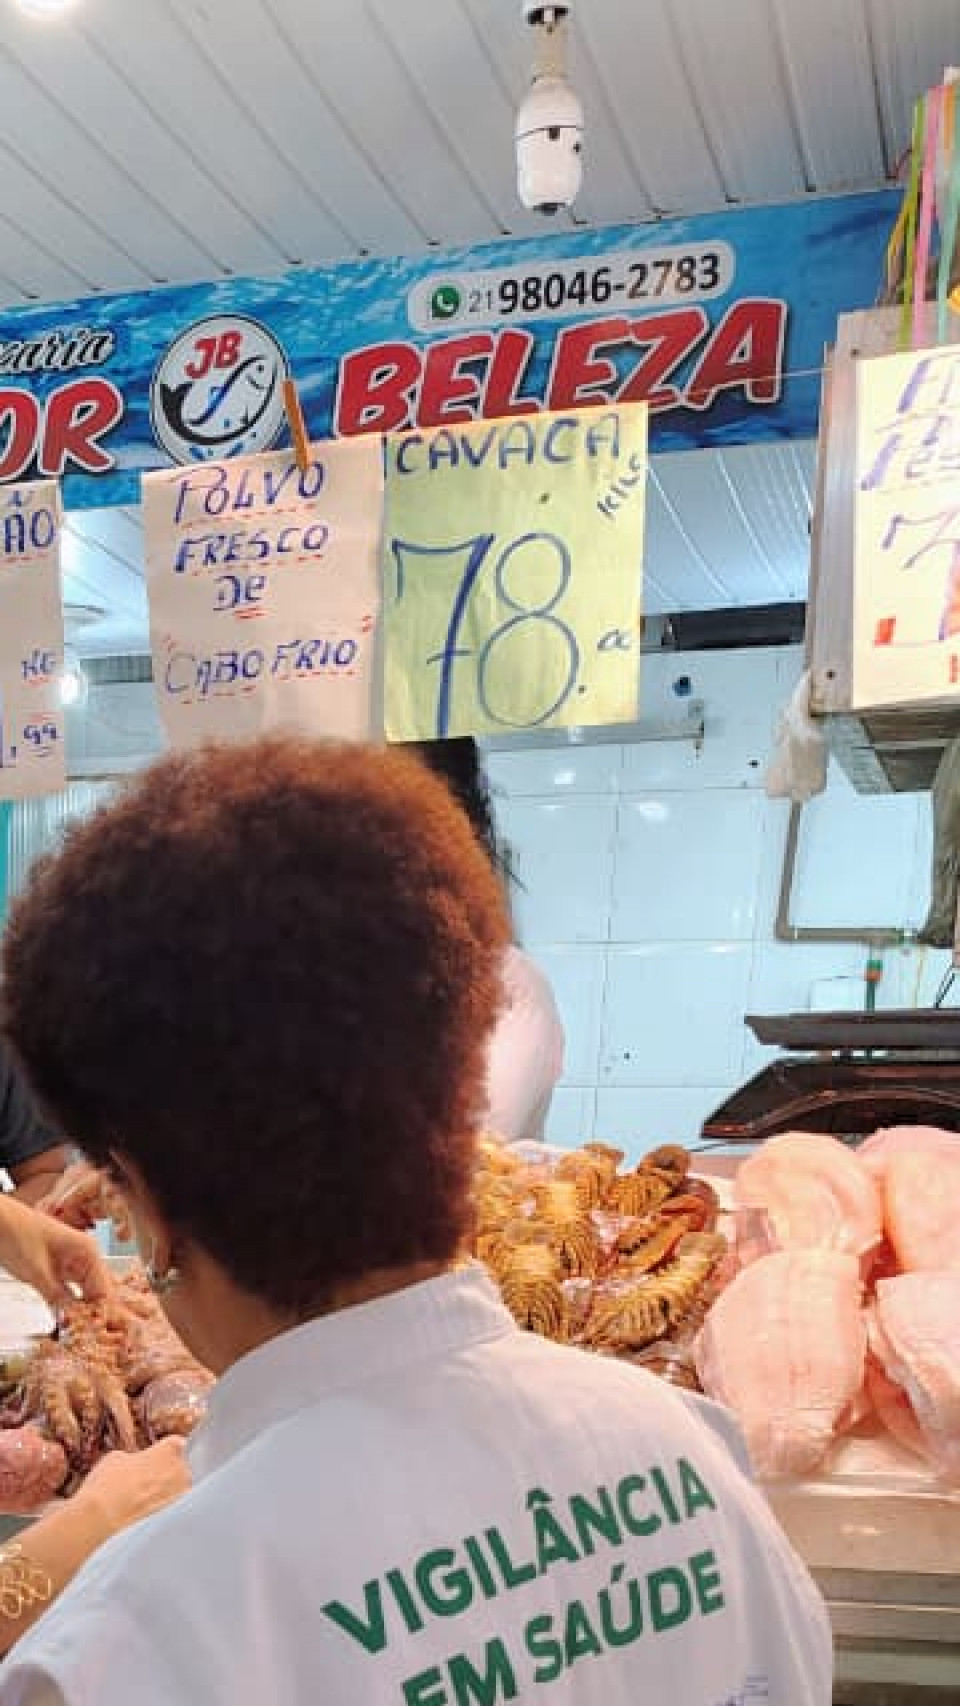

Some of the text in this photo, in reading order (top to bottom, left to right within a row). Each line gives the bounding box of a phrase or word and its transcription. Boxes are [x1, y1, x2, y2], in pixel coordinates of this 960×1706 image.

[469, 252, 722, 316] 21 98046-2783
[184, 330, 242, 379] JB
[334, 298, 787, 438] BELEZA
[396, 412, 620, 475] CAVACA
[171, 462, 326, 523] POLVO
[173, 524, 330, 573] FRESCO
[165, 639, 358, 694] CABO FRIO
[319, 1456, 718, 1656] VIGILÂNCIA
[523, 1548, 727, 1684] SAÚDE
